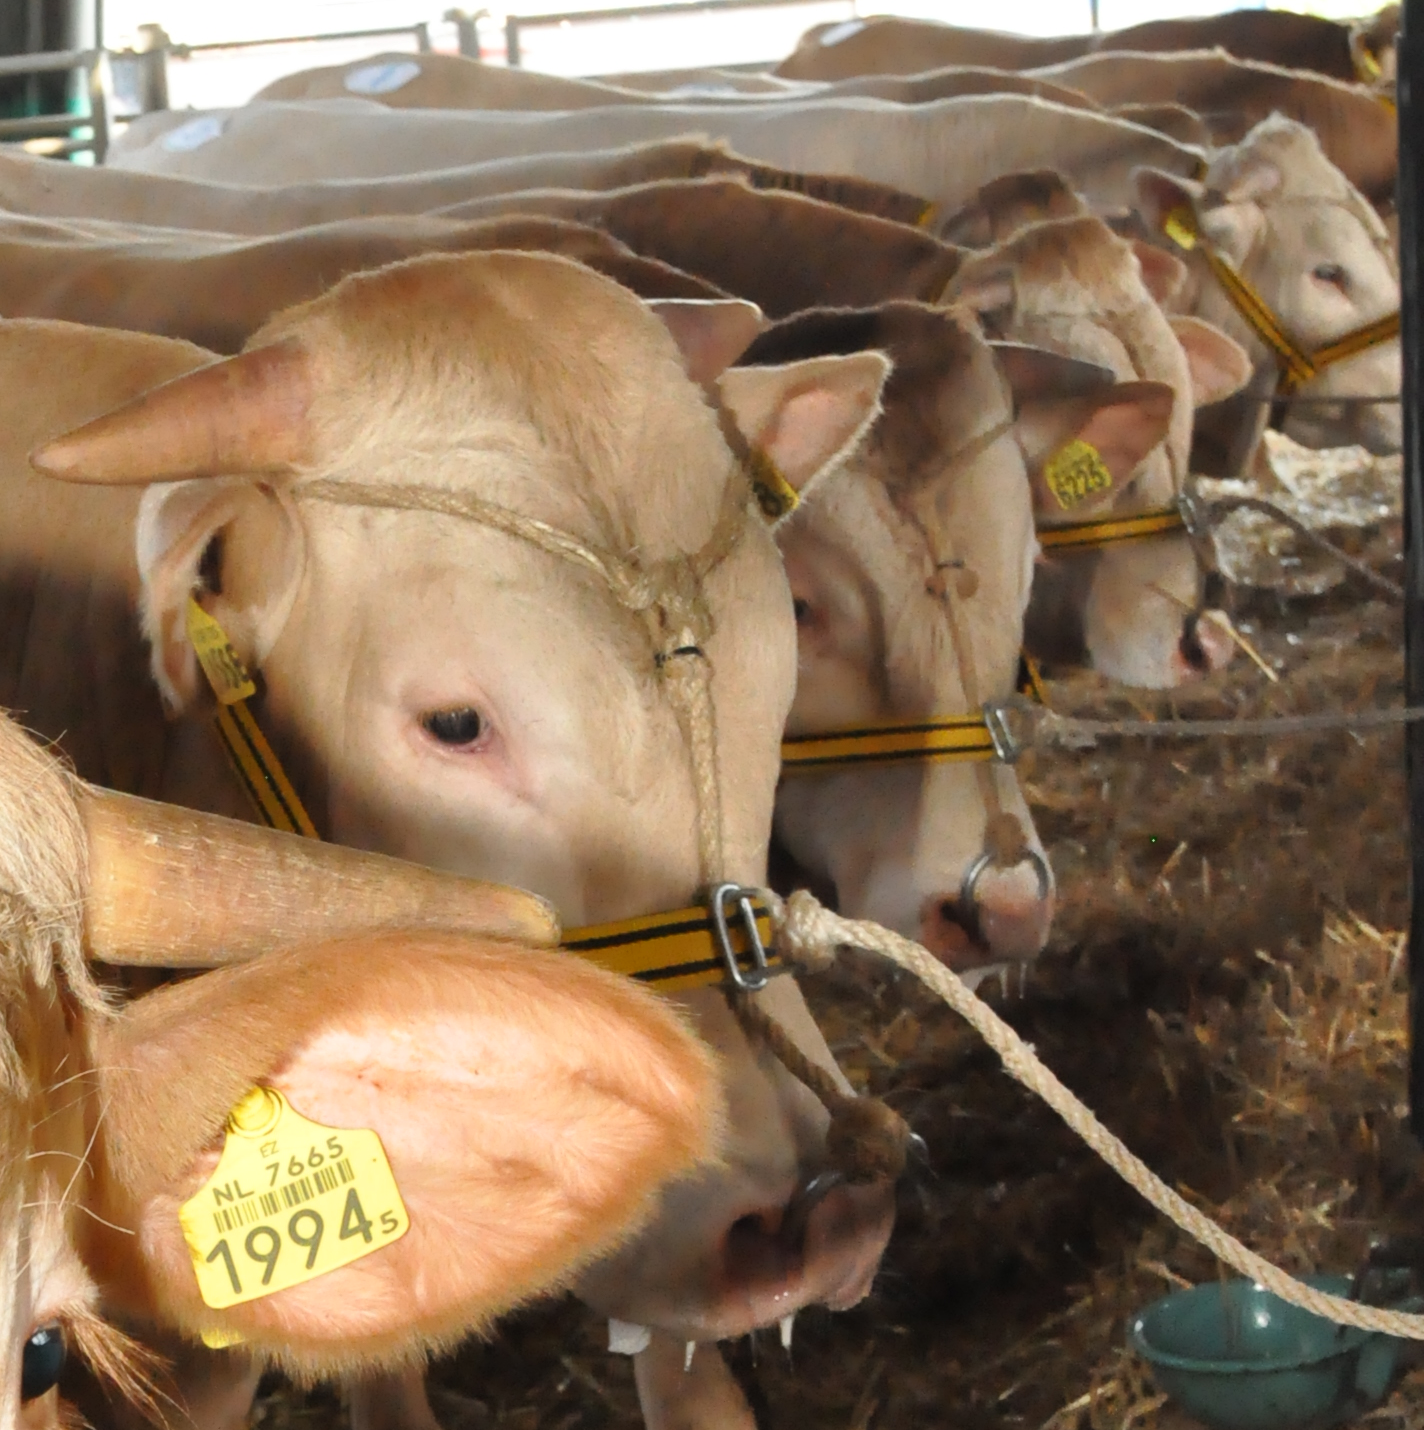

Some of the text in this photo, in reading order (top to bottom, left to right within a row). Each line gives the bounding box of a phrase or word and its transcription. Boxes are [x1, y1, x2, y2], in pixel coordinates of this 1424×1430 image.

[213, 1136, 343, 1206] NL 7665
[206, 1188, 373, 1294] 1994
